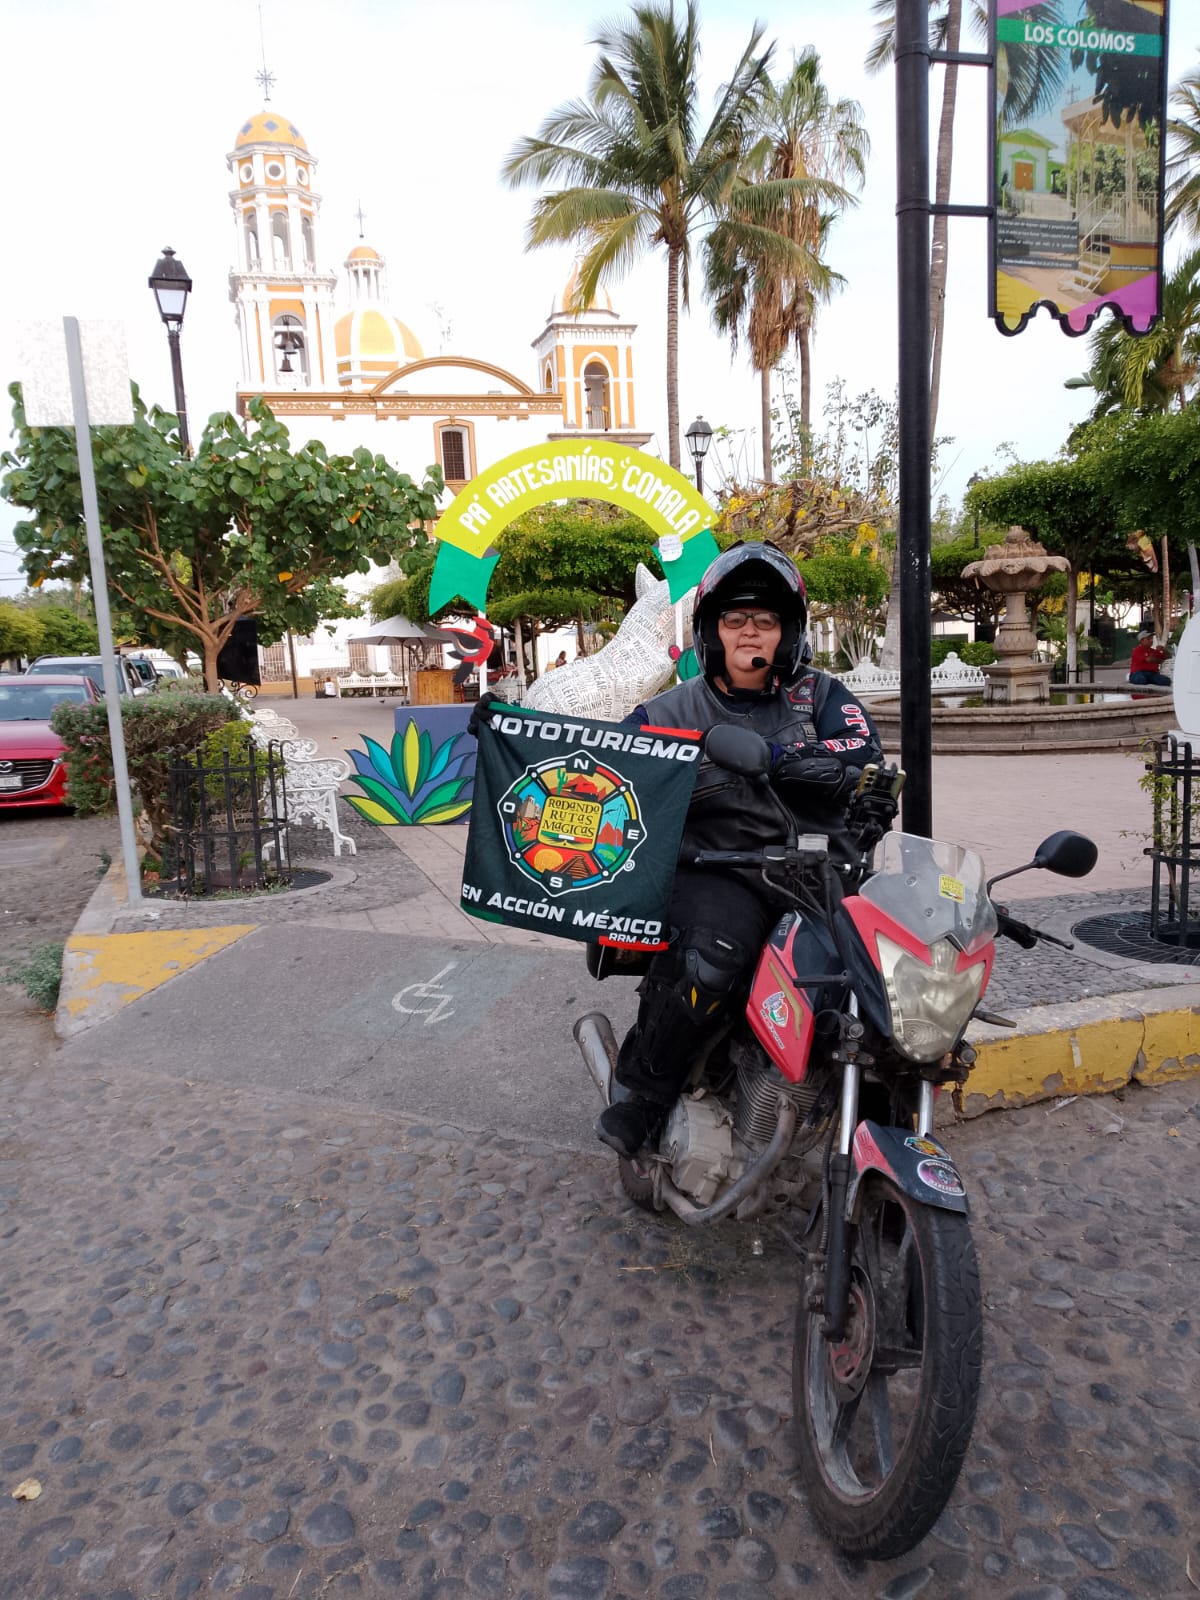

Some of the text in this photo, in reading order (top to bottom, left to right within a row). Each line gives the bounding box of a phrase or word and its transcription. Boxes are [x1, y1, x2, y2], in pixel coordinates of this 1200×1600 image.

[1025, 24, 1135, 52] LOS COLOMOS
[574, 758, 589, 770] N
[627, 829, 640, 840] E
[549, 876, 563, 888] S
[462, 883, 662, 936] EN ACCIÓN MÉXICO
[608, 932, 661, 946] RRM 4.0
